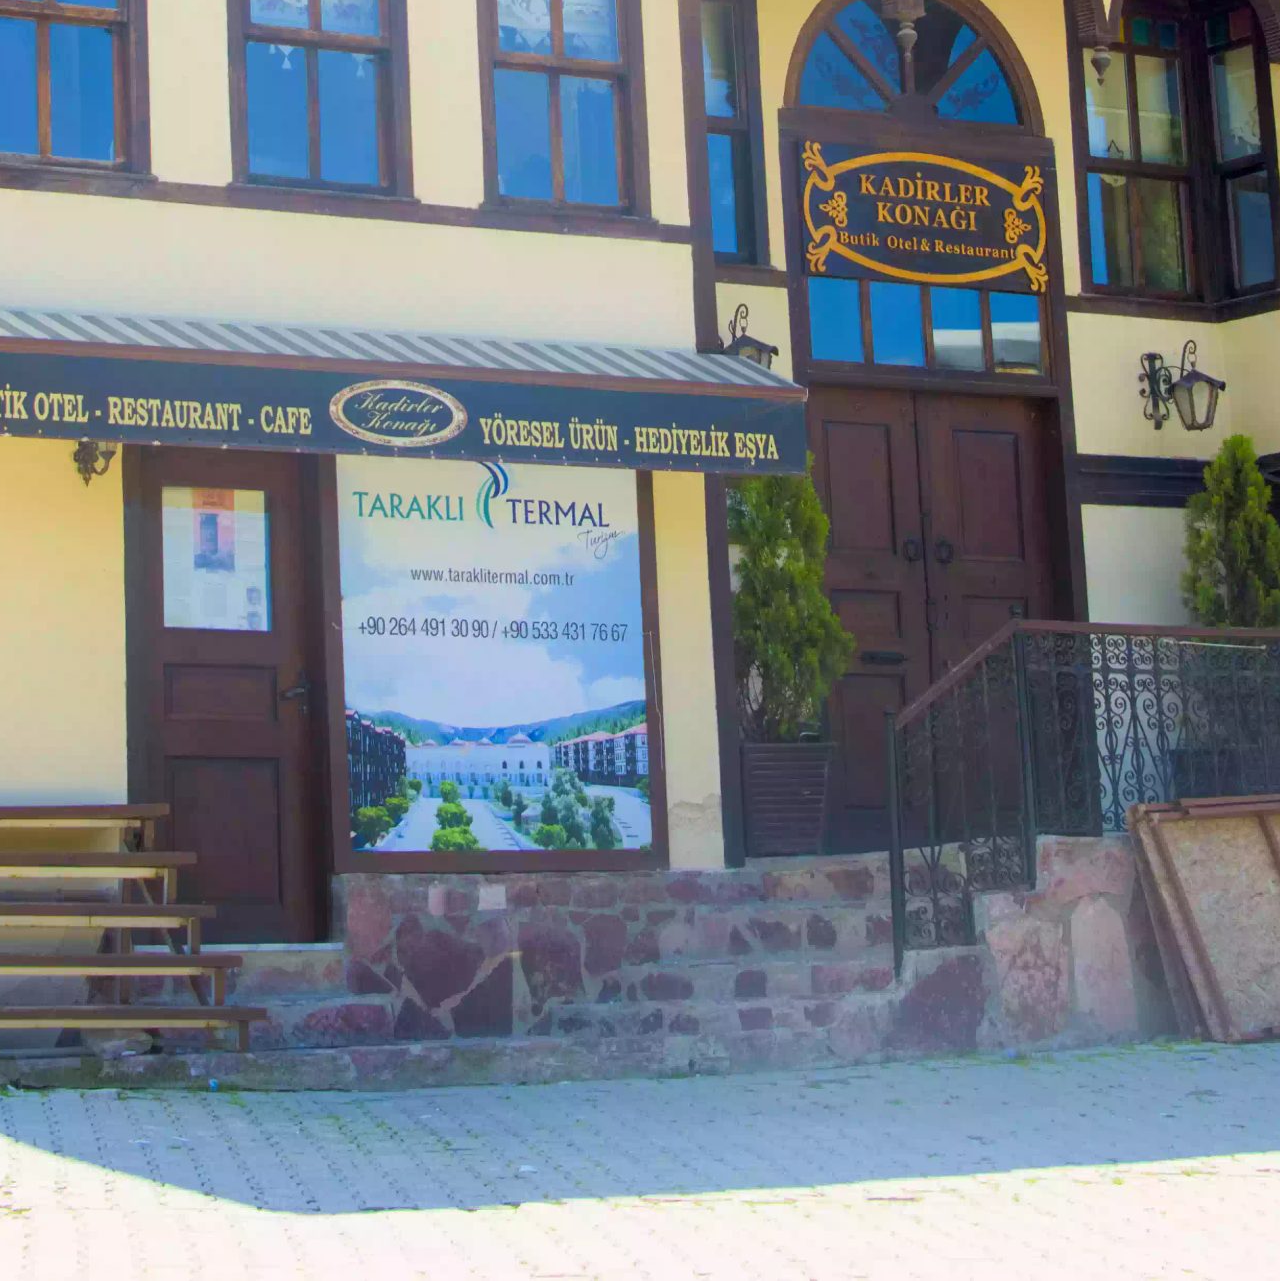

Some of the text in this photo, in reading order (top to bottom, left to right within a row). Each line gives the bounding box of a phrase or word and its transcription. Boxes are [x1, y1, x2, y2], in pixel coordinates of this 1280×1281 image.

[859, 172, 991, 207] KADİRLER
[877, 201, 977, 231] KONAĞI
[837, 230, 1016, 259] Butik Otel & Restaurant
[33, 392, 89, 423] OTEL
[108, 395, 241, 431] RESTAURANT
[260, 405, 313, 435] CAFE
[354, 392, 444, 414] Kadirler
[362, 410, 437, 438] Konağı
[480, 412, 564, 448] YÖRESEL
[569, 417, 618, 451] ÜRÜN
[634, 422, 731, 458] HEDİYELİK
[735, 432, 780, 465] EŞYA
[352, 491, 610, 528] TARAKLI TERMAL
[411, 567, 575, 587] www.taraklitermal.com.tr
[358, 616, 385, 636] +90
[389, 617, 416, 636] 264
[421, 618, 446, 637] 491
[451, 619, 469, 637] 30
[472, 619, 489, 638] 90
[502, 620, 529, 639] +90
[532, 621, 558, 640] 533
[562, 622, 586, 640] 431
[591, 622, 608, 641] 76
[611, 623, 628, 642] 67
